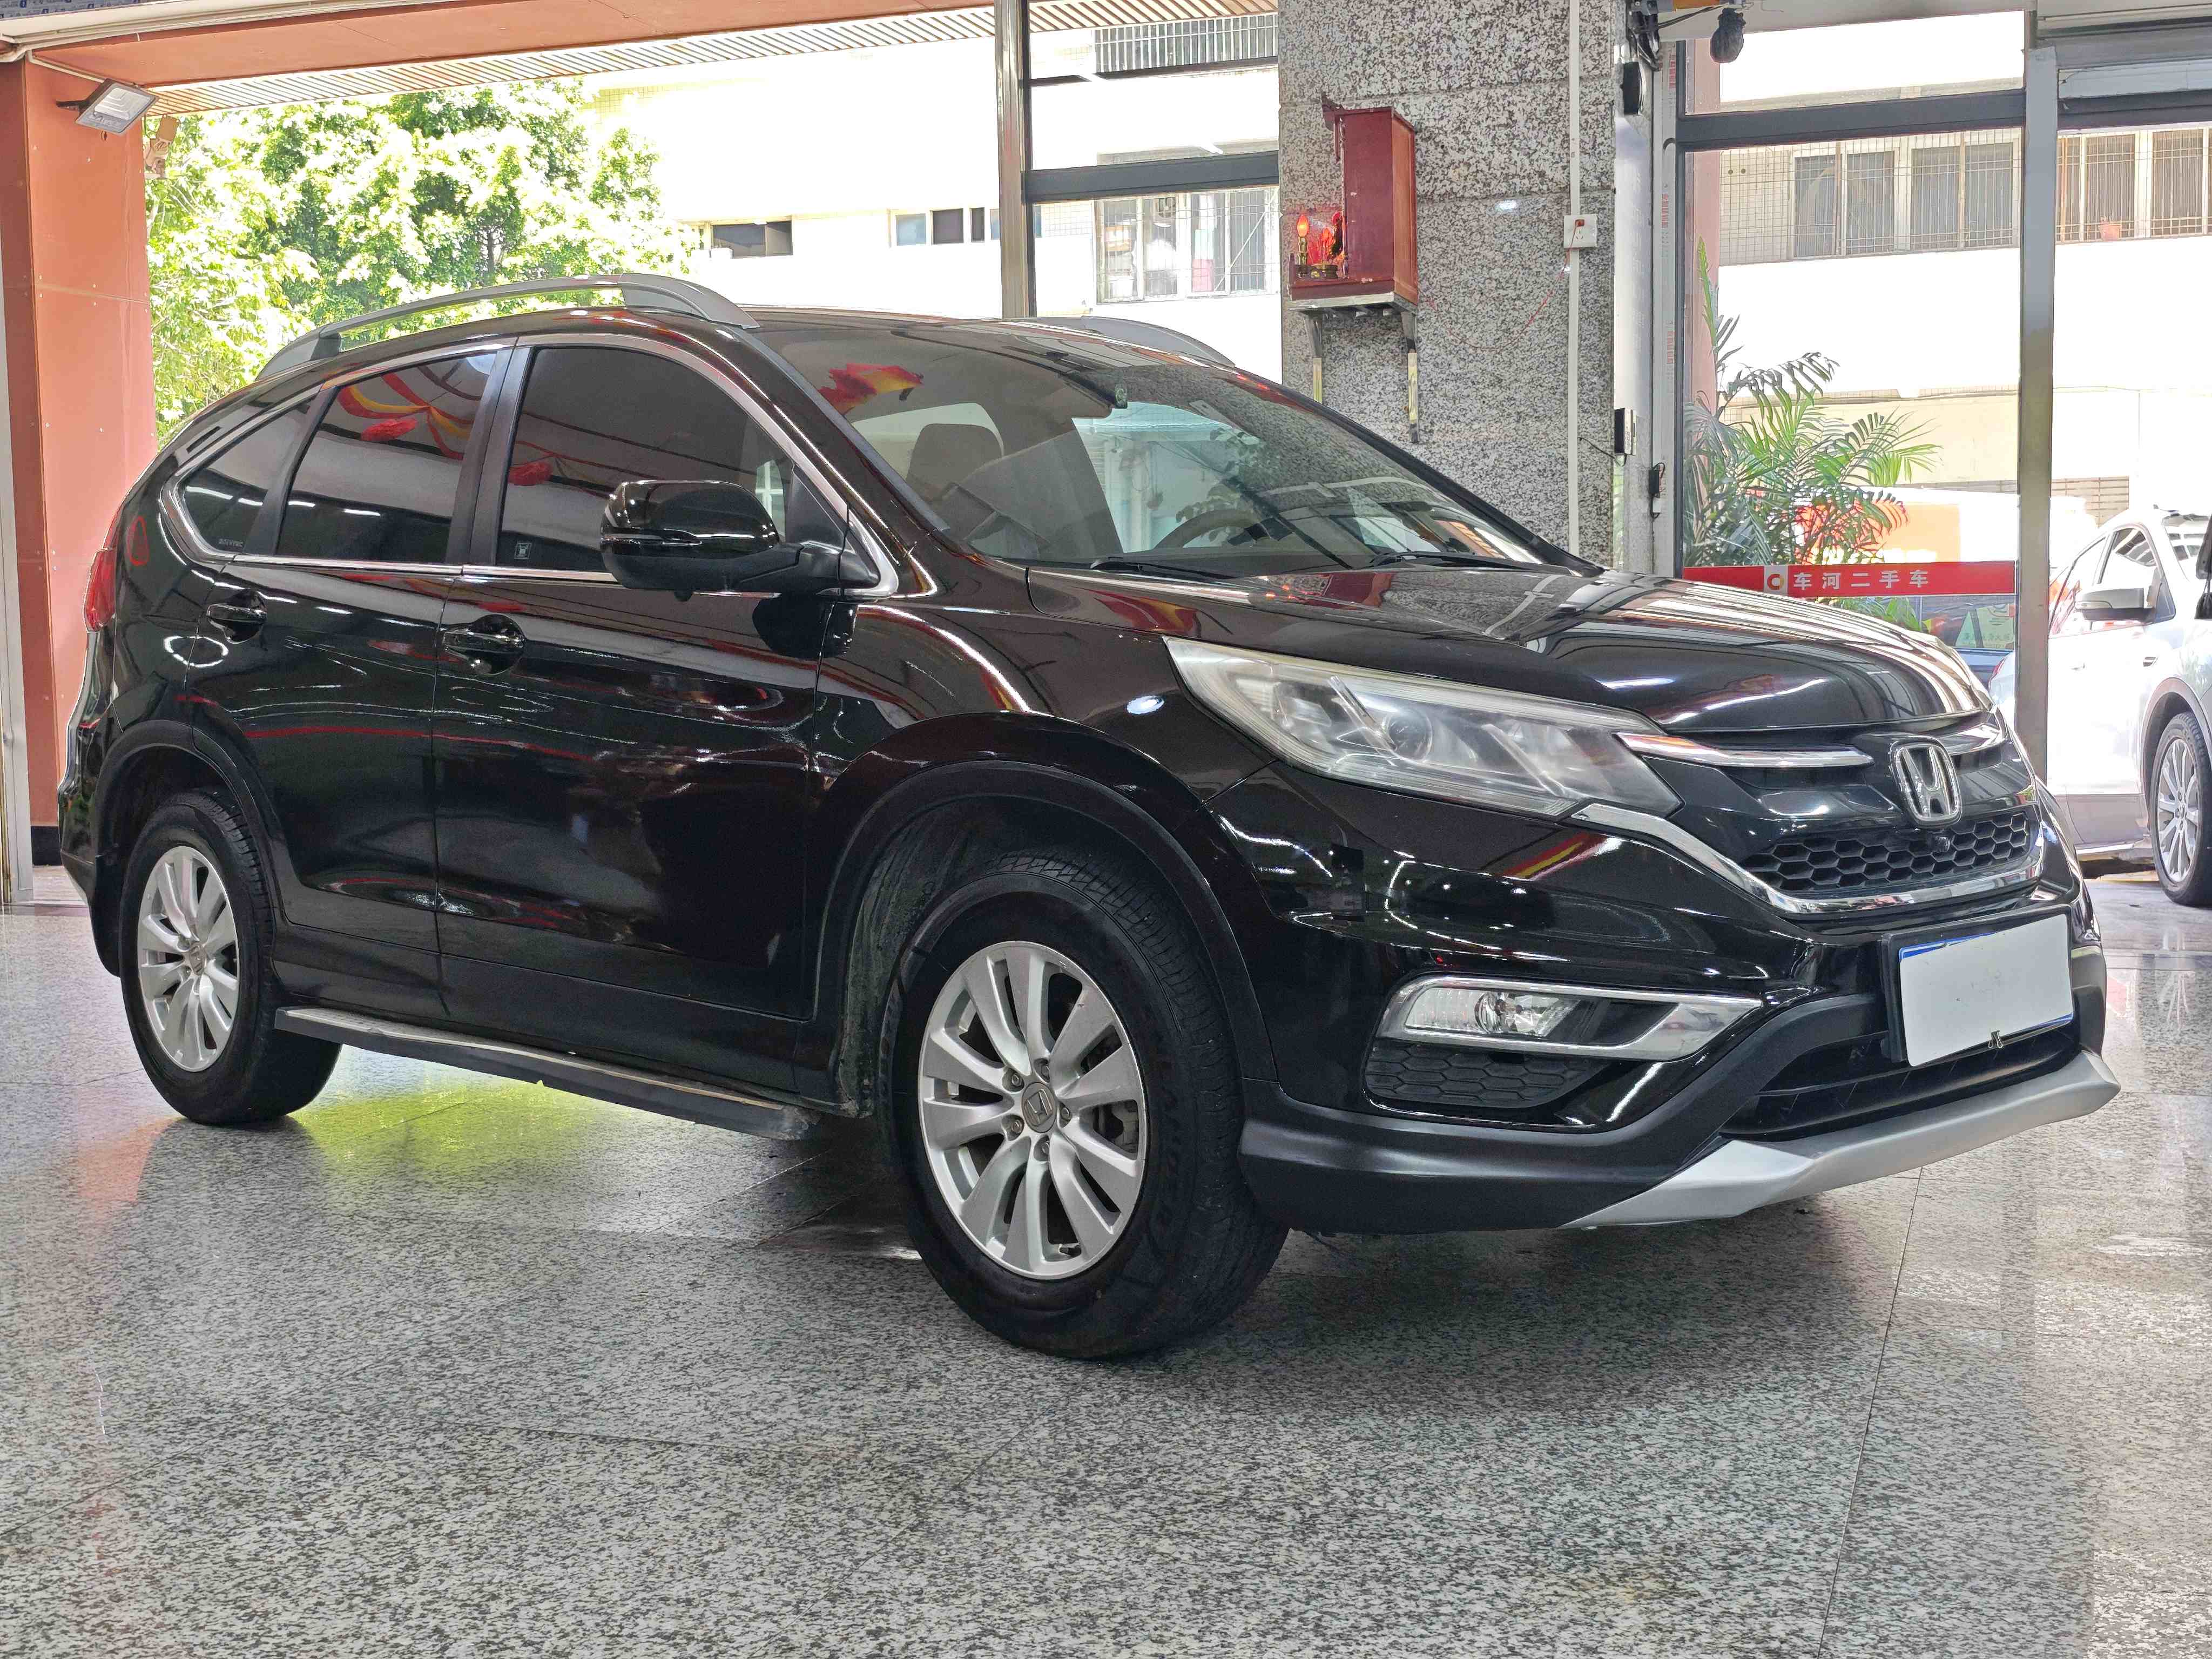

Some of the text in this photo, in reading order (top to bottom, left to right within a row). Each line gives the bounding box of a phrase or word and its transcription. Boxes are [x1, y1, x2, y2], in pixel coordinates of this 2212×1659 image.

[1793, 570, 1928, 590] 车河二手车
